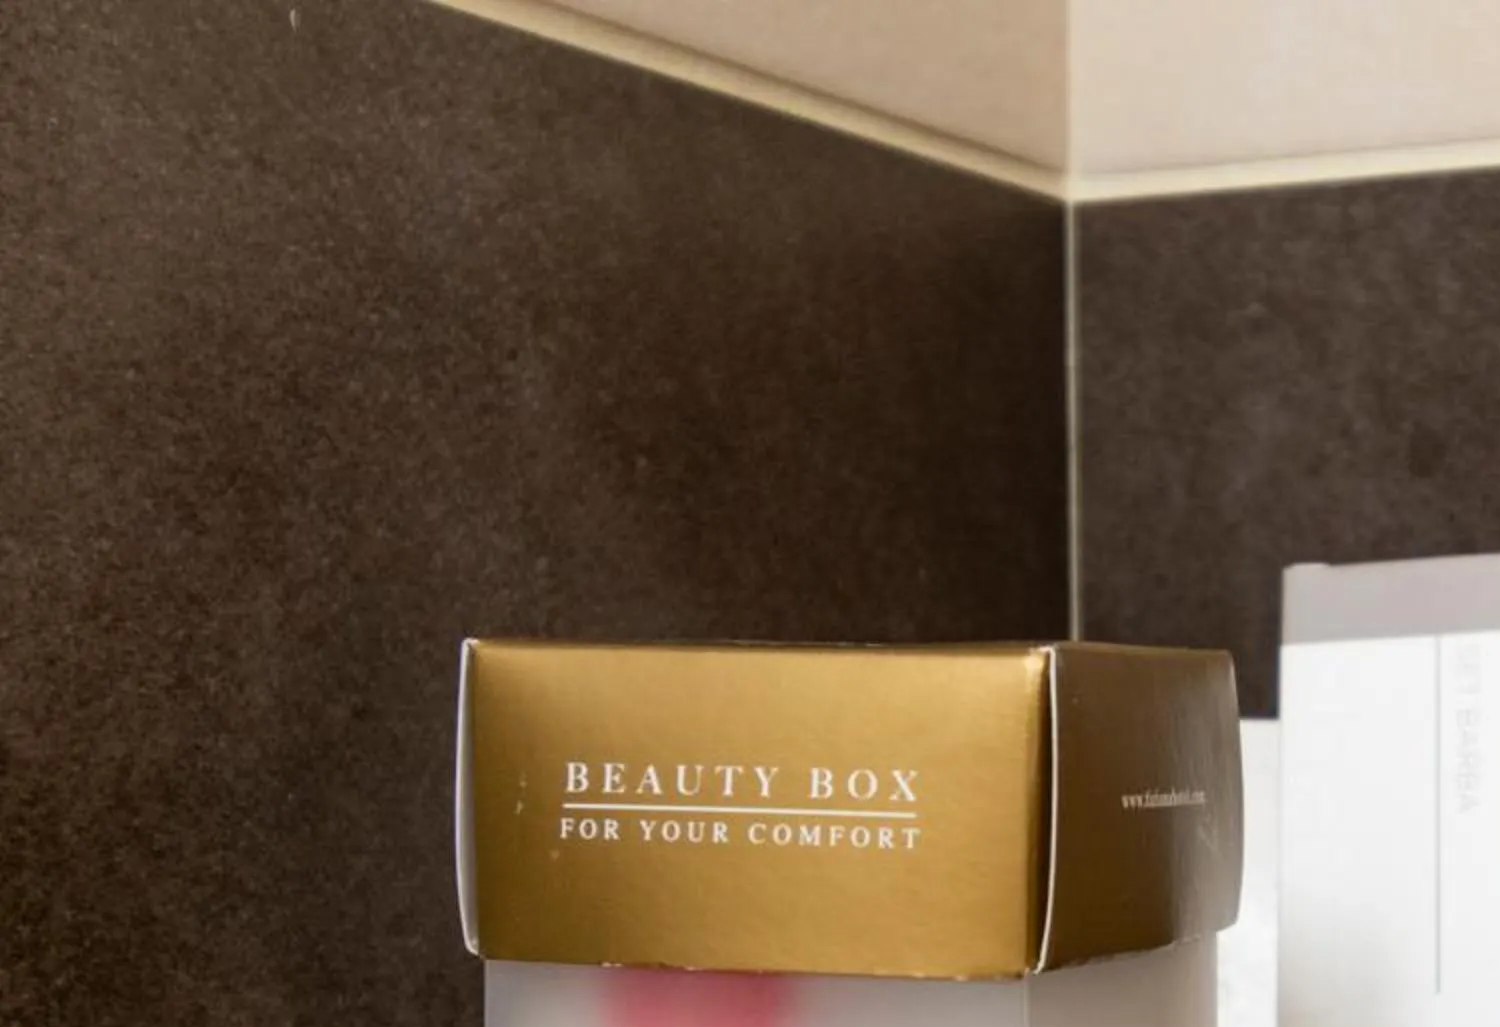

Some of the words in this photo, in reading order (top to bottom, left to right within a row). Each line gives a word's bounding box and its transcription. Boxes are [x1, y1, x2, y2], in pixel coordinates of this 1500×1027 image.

[565, 761, 779, 798] BEAUTY
[809, 767, 919, 802] BOX
[559, 818, 621, 840] FOR
[639, 820, 729, 843] YOUR
[747, 823, 921, 849] COMFORT
